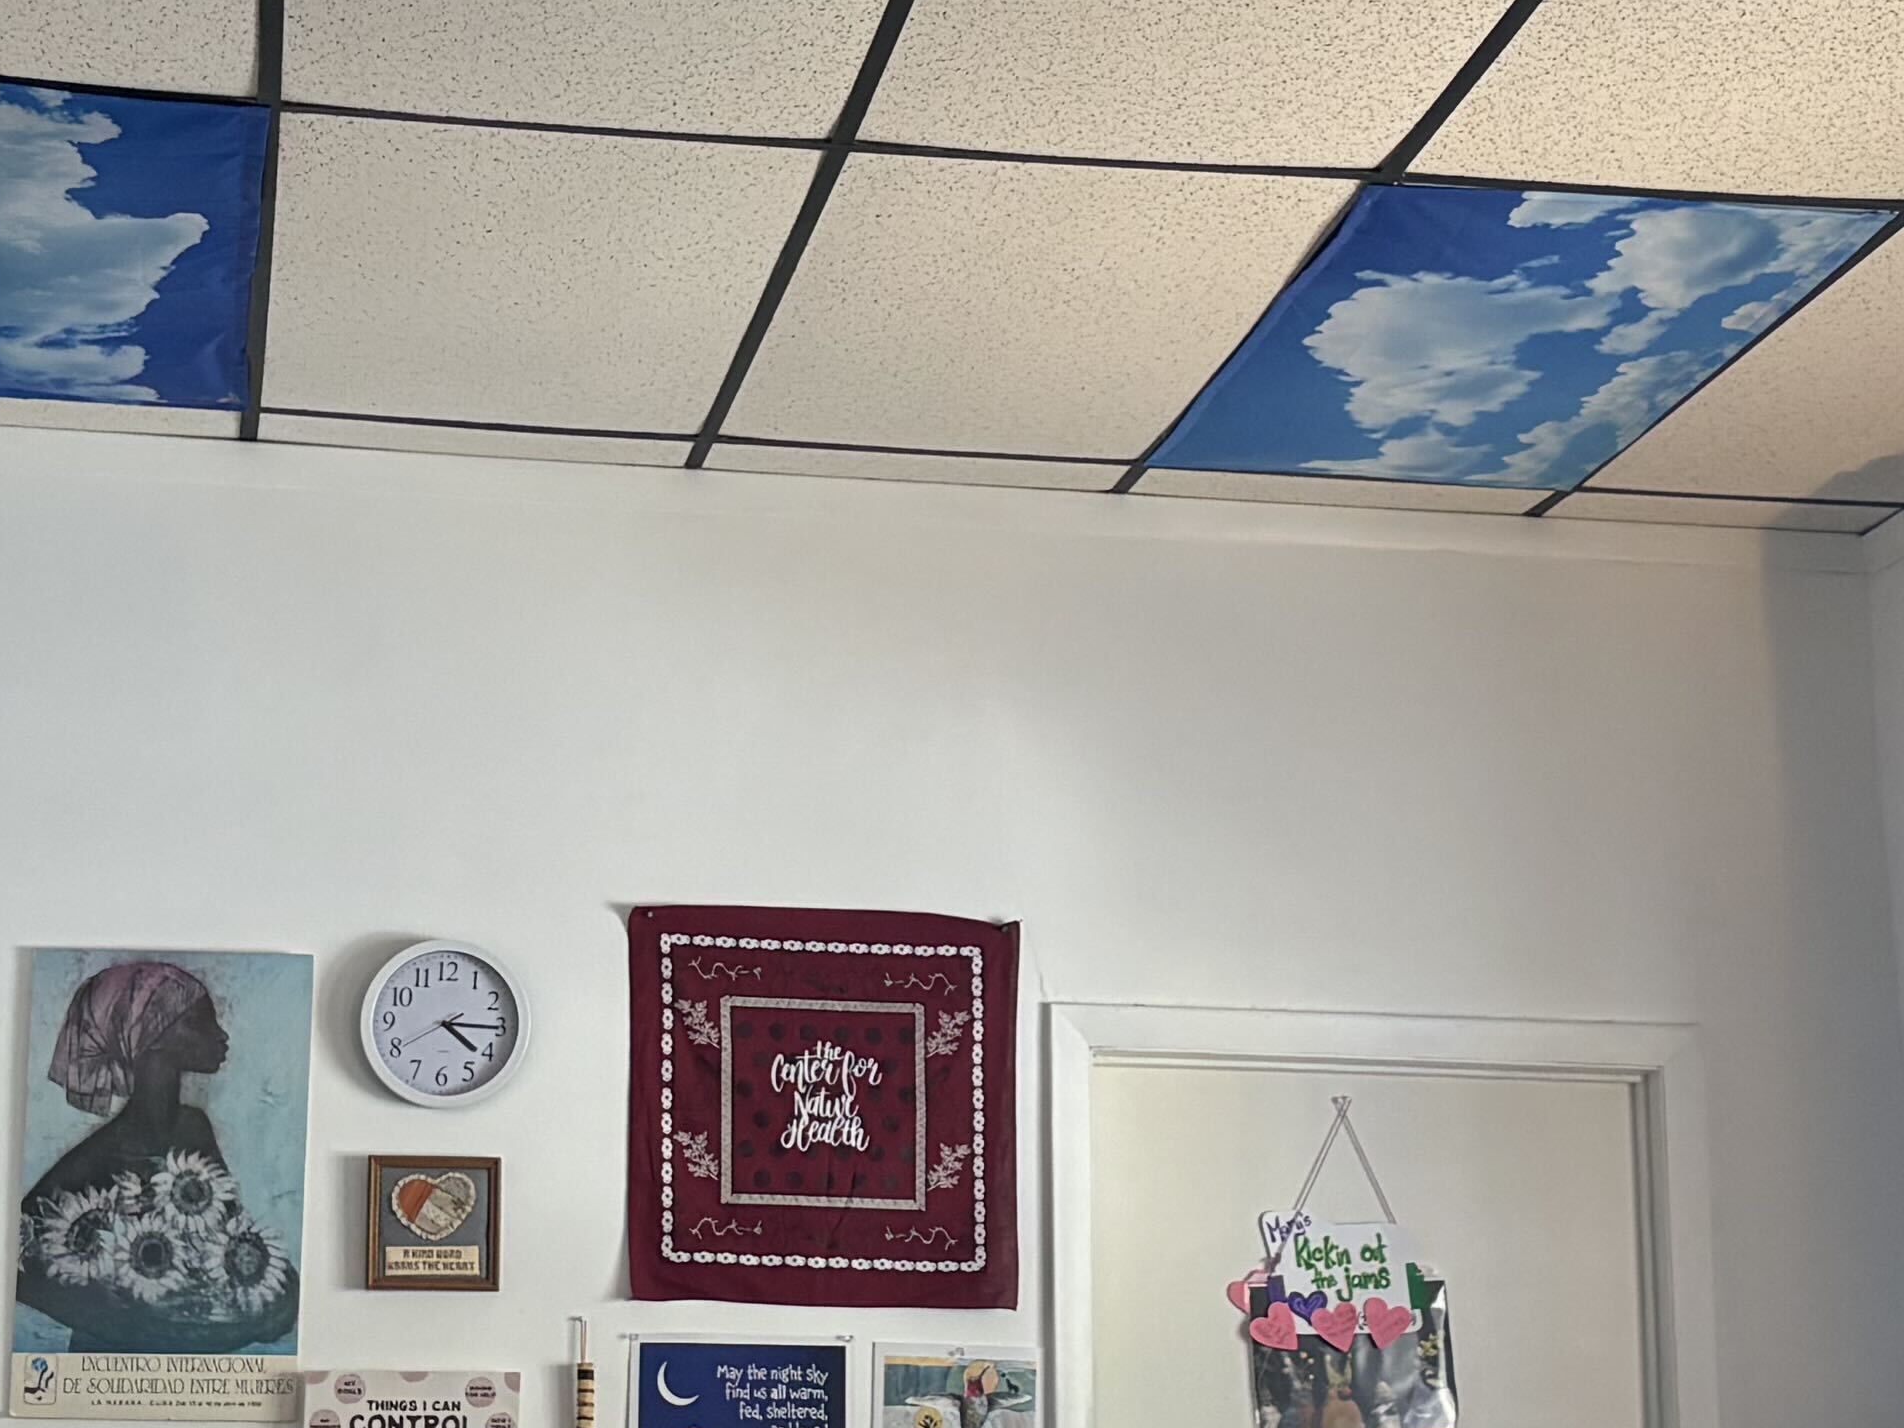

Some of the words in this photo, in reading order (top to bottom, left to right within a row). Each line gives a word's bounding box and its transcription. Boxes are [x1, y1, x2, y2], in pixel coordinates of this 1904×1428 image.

[414, 967, 430, 988] 11
[438, 961, 459, 982] 12
[471, 970, 479, 990] 1
[392, 986, 413, 1007] 10
[487, 991, 499, 1011] 2
[383, 1011, 395, 1032] 9
[495, 1016, 506, 1037] 3
[389, 1037, 402, 1058] 8
[481, 1042, 494, 1062] 4
[813, 1040, 844, 1060] the
[410, 1059, 422, 1080] 7
[435, 1065, 448, 1087] 6
[462, 1061, 475, 1082] 5
[771, 1050, 840, 1093] Center
[841, 1050, 882, 1102] for
[794, 1084, 859, 1119] Native
[781, 1115, 870, 1152] Health
[1336, 1267, 1391, 1302] jams
[81, 1356, 161, 1373] ENCUENTRO
[166, 1356, 267, 1373] INTERNACIONAL
[63, 1377, 82, 1394] DE
[86, 1377, 185, 1394] SOLIDARIDAD
[190, 1378, 229, 1394] ENTRE
[717, 1365, 743, 1387] May
[747, 1364, 767, 1380] the
[770, 1364, 802, 1383] night
[806, 1364, 828, 1386] sky
[725, 1382, 750, 1400] find
[754, 1387, 767, 1399] us
[770, 1384, 786, 1400] all
[789, 1387, 828, 1401] warm,
[366, 1400, 417, 1412] THINGS
[422, 1401, 426, 1412] I
[432, 1401, 461, 1412] CAN
[740, 1401, 763, 1420] fed,
[766, 1401, 828, 1420] sheltered,
